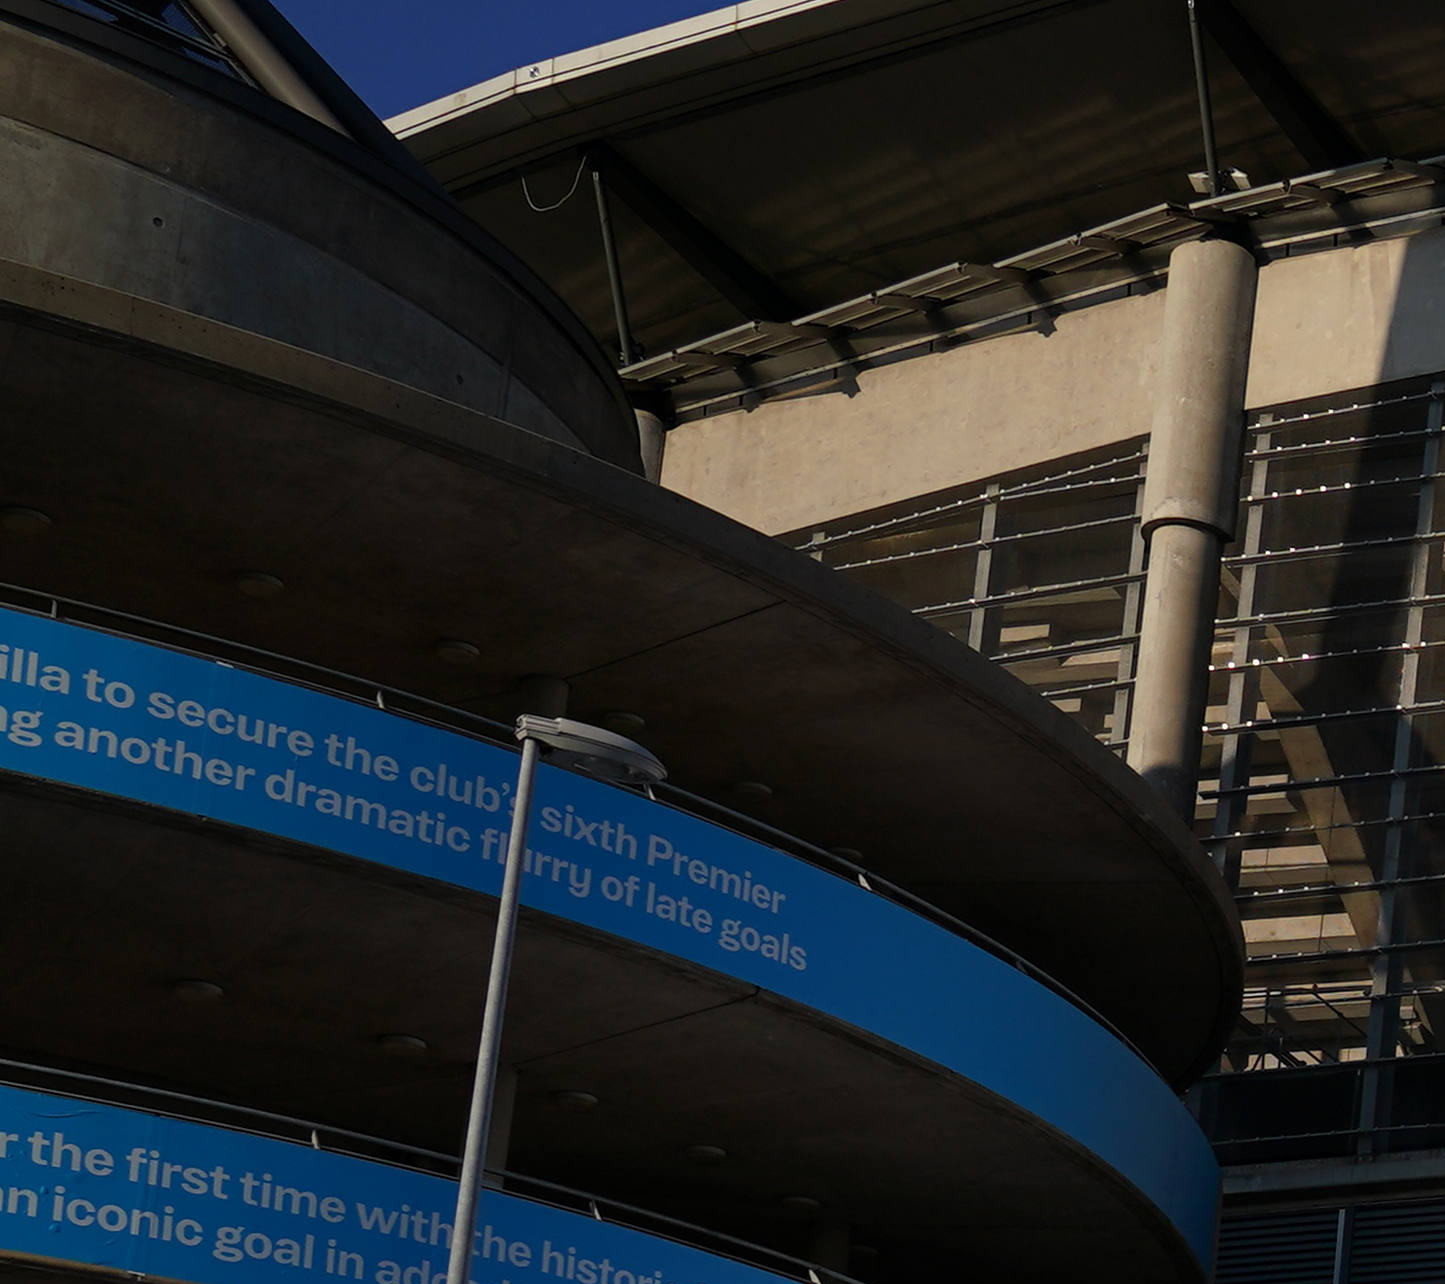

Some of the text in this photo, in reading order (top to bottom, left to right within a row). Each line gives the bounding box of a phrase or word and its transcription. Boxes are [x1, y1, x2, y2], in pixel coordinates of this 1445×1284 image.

[55, 720, 808, 972] another dramatic flrry of late goals
[83, 669, 787, 915] to secure the sixth Premier
[28, 1130, 115, 1177] the
[126, 1147, 230, 1200] first
[240, 1171, 347, 1224] time
[356, 1203, 453, 1250] with
[51, 1186, 204, 1247] iconic
[212, 1225, 315, 1270] goal
[326, 1238, 364, 1280] in
